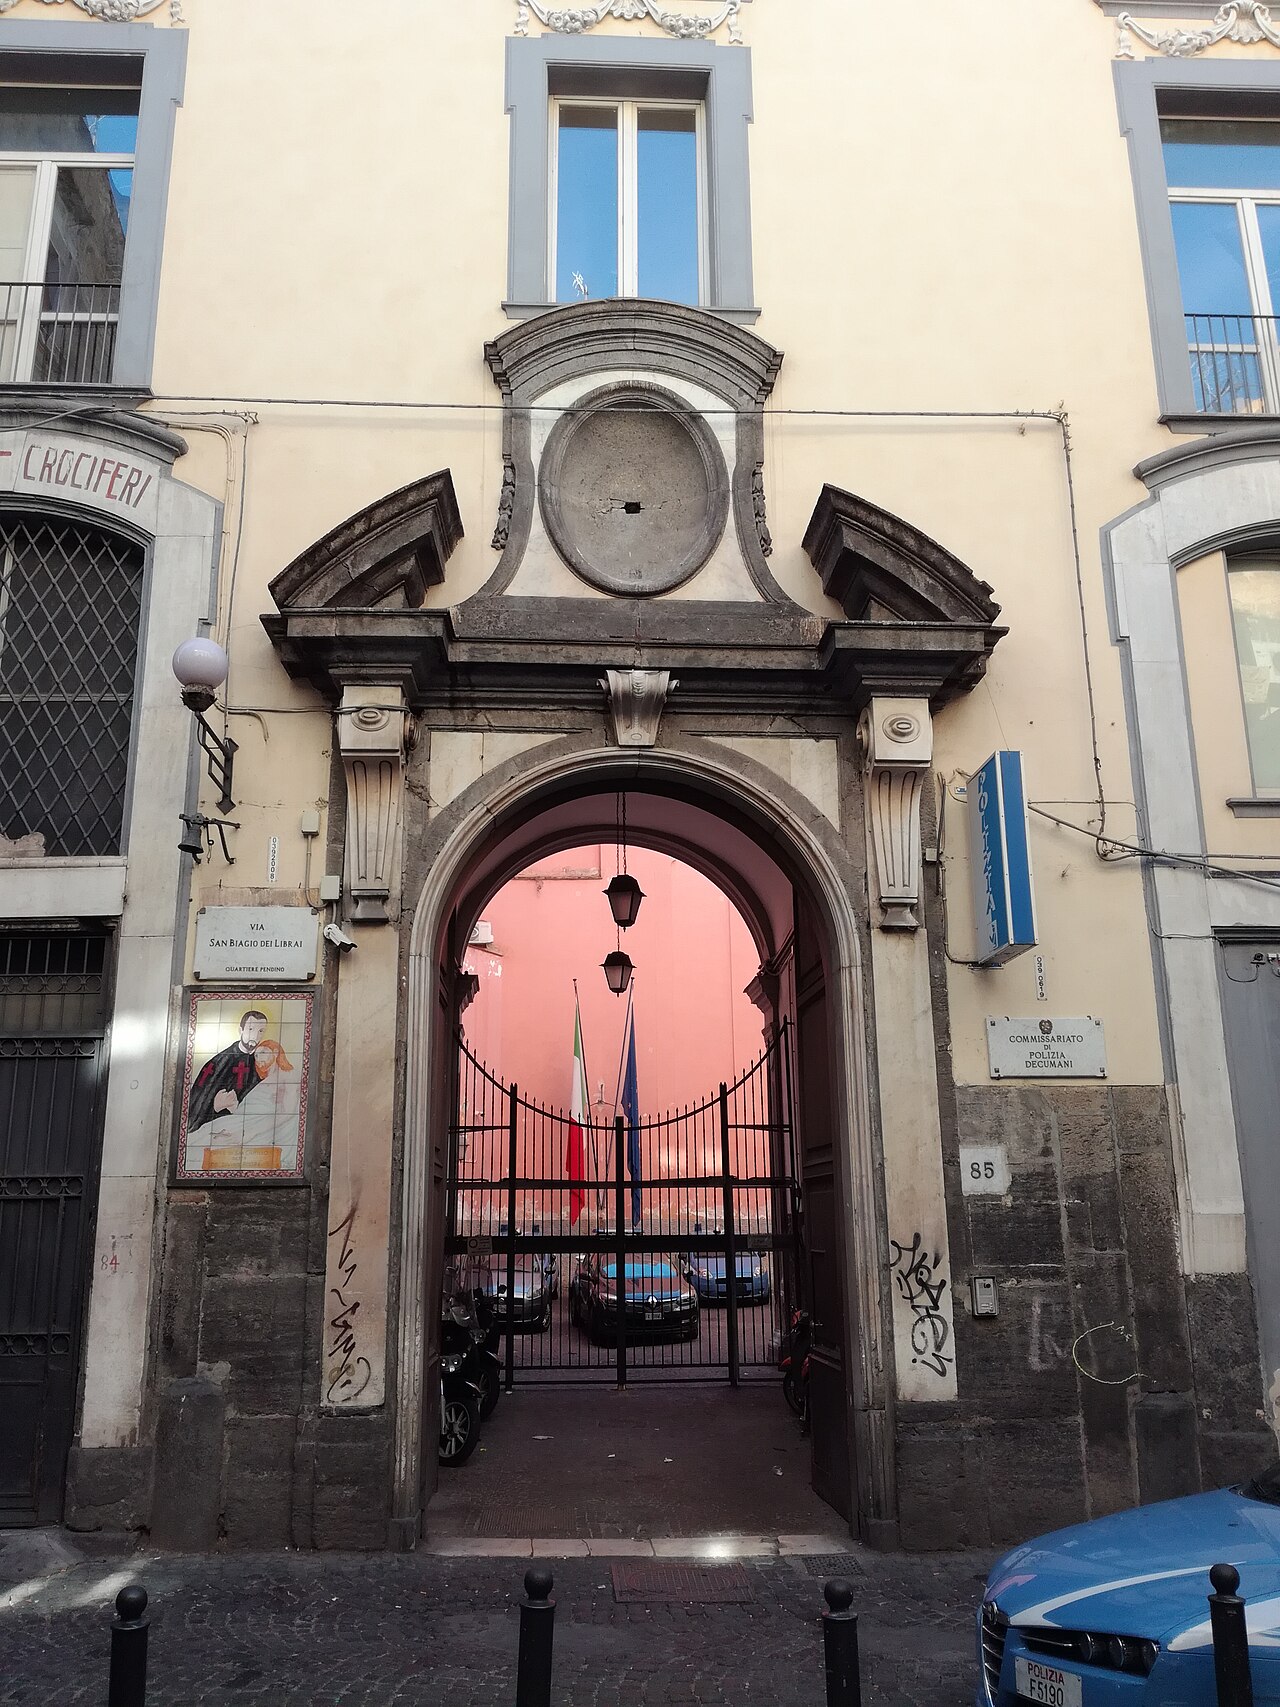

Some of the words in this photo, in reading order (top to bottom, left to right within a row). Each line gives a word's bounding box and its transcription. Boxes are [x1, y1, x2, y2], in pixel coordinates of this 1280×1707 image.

[23, 444, 152, 508] CROCIFERI
[978, 771, 996, 915] POLIZIA
[250, 923, 265, 931] VIA
[209, 938, 228, 947] SAN
[230, 938, 258, 948] BIAGIO
[260, 940, 273, 948] DEI
[274, 939, 303, 948] LIBRAI
[1009, 1035, 1084, 1043] COMMISSARIATO
[970, 1161, 995, 1180] 85
[101, 1252, 120, 1271] 84
[1027, 1662, 1065, 1685] POLIZIA
[1029, 1678, 1064, 1707] F5190
